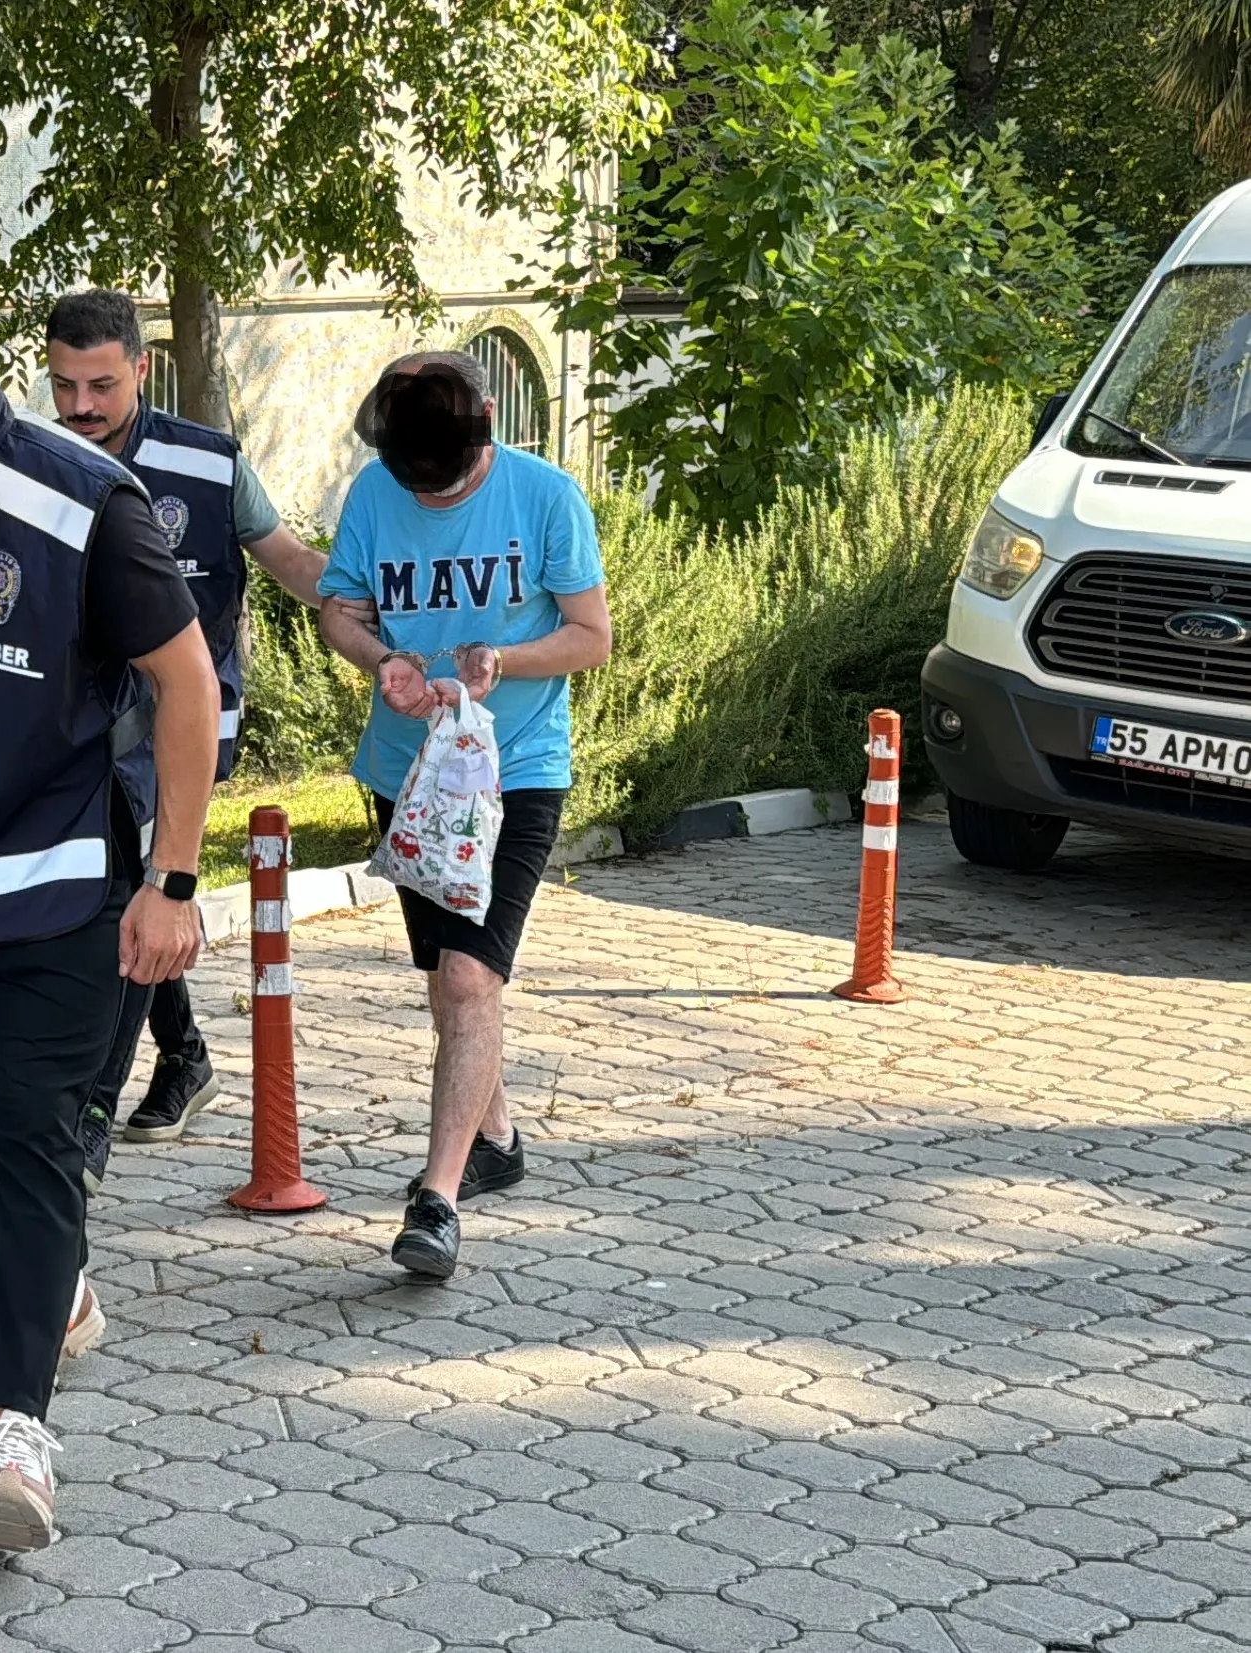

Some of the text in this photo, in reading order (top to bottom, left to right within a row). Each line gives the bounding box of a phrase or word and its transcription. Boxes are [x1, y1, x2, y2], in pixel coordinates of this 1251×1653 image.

[378, 539, 523, 613] MAVİ
[1181, 617, 1226, 639] Ford
[1095, 736, 1107, 747] TR
[1109, 723, 1149, 756] 55
[1159, 734, 1228, 771] APM
